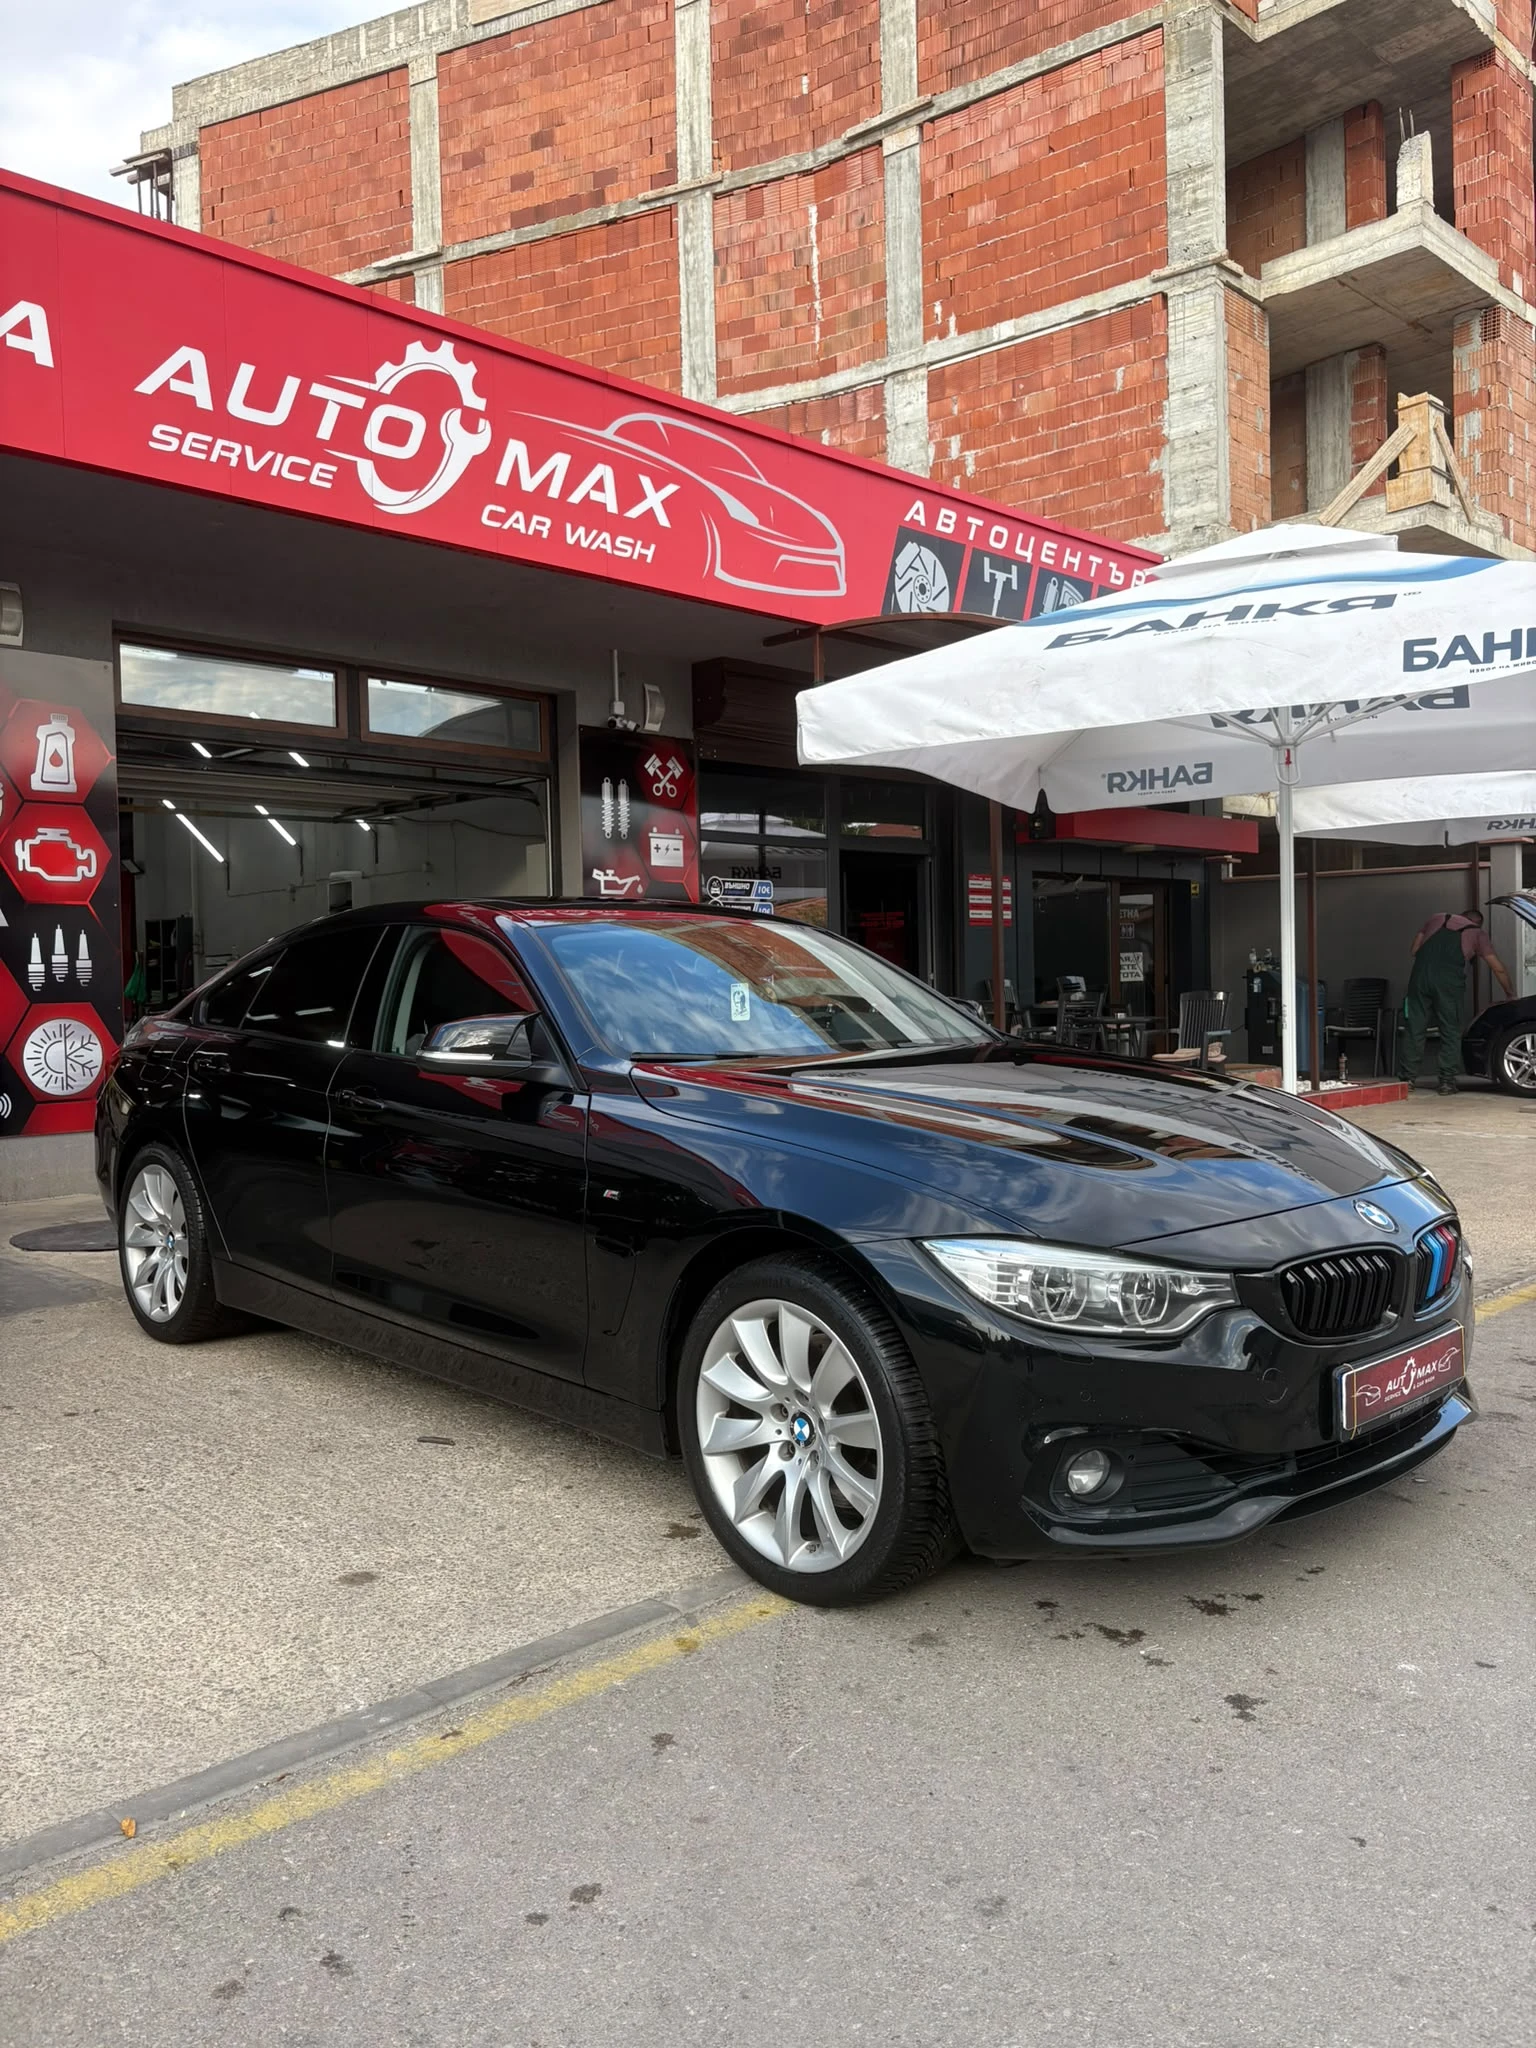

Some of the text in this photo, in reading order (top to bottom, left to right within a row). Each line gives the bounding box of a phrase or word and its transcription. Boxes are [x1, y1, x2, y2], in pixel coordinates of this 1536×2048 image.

[134, 345, 681, 528] AUTO MAX
[148, 424, 338, 489] SERVICE
[481, 503, 656, 563] CAR WASH
[904, 499, 1148, 589] АВТОЦЕНТЪР
[1416, 1359, 1438, 1380] MAX
